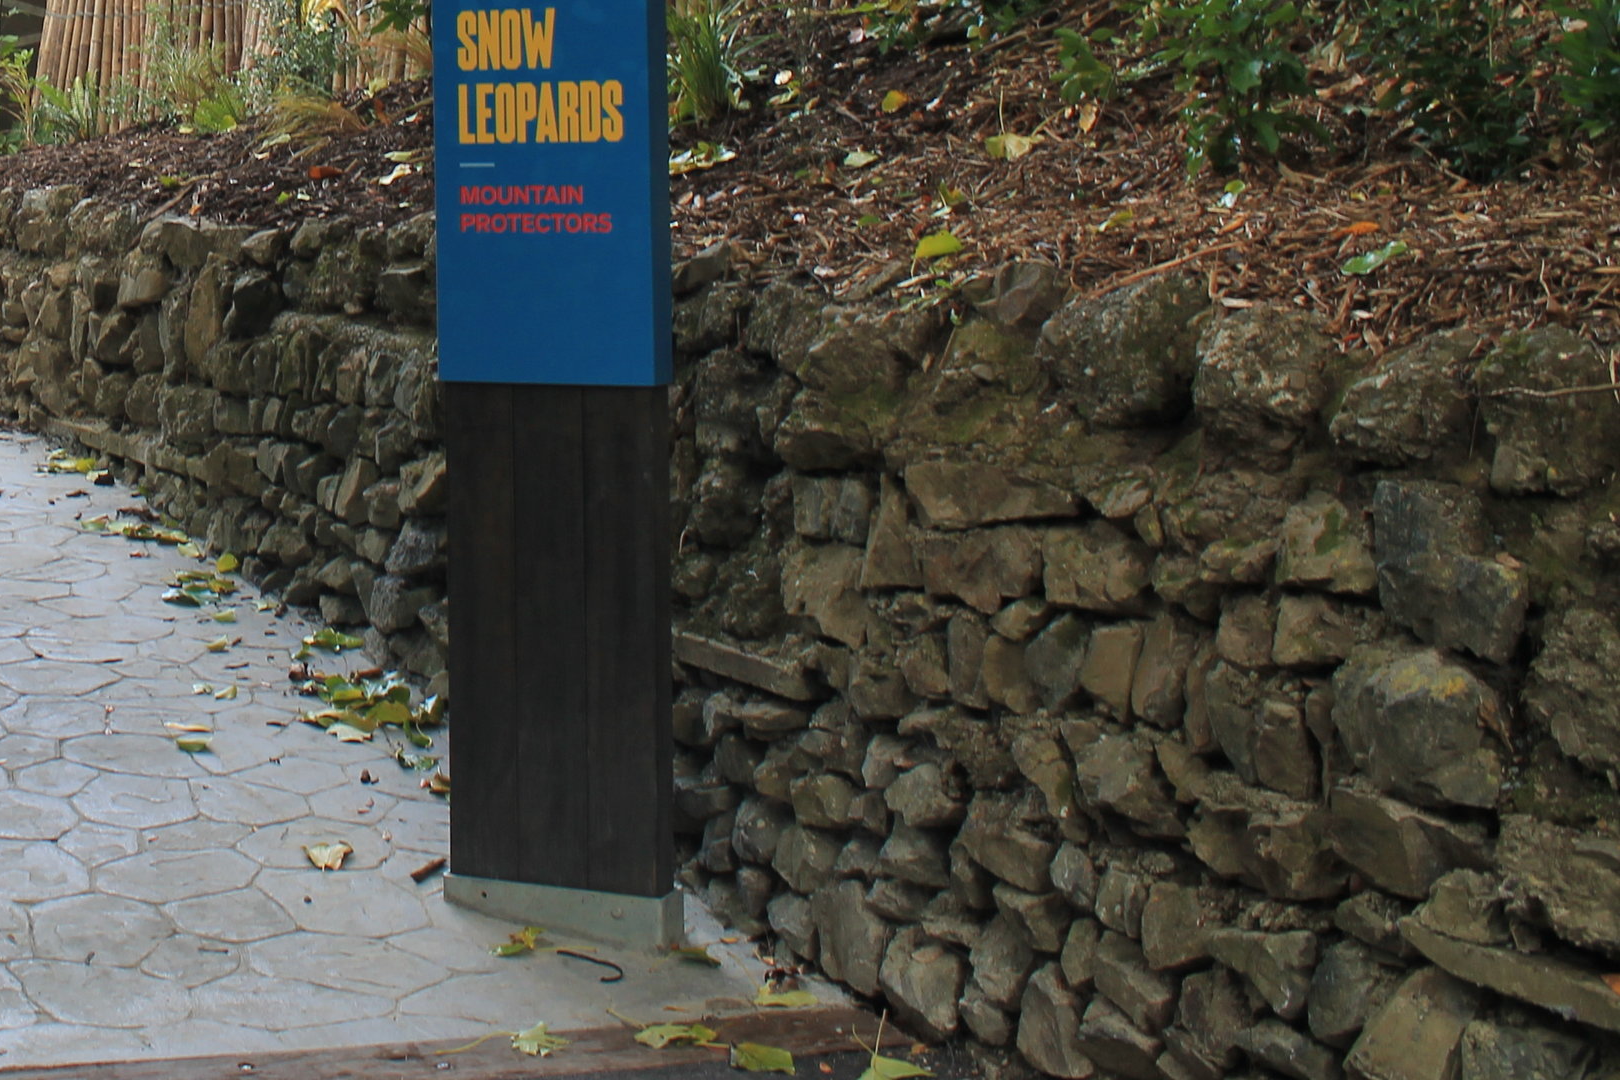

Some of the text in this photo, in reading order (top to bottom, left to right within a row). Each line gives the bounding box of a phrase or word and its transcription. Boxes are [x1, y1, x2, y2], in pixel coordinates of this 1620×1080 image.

[457, 8, 555, 70] SNOW
[458, 80, 623, 144] LEOPARDS
[460, 185, 584, 205] MOUNTAIN
[460, 213, 612, 233] PROTECTORS
